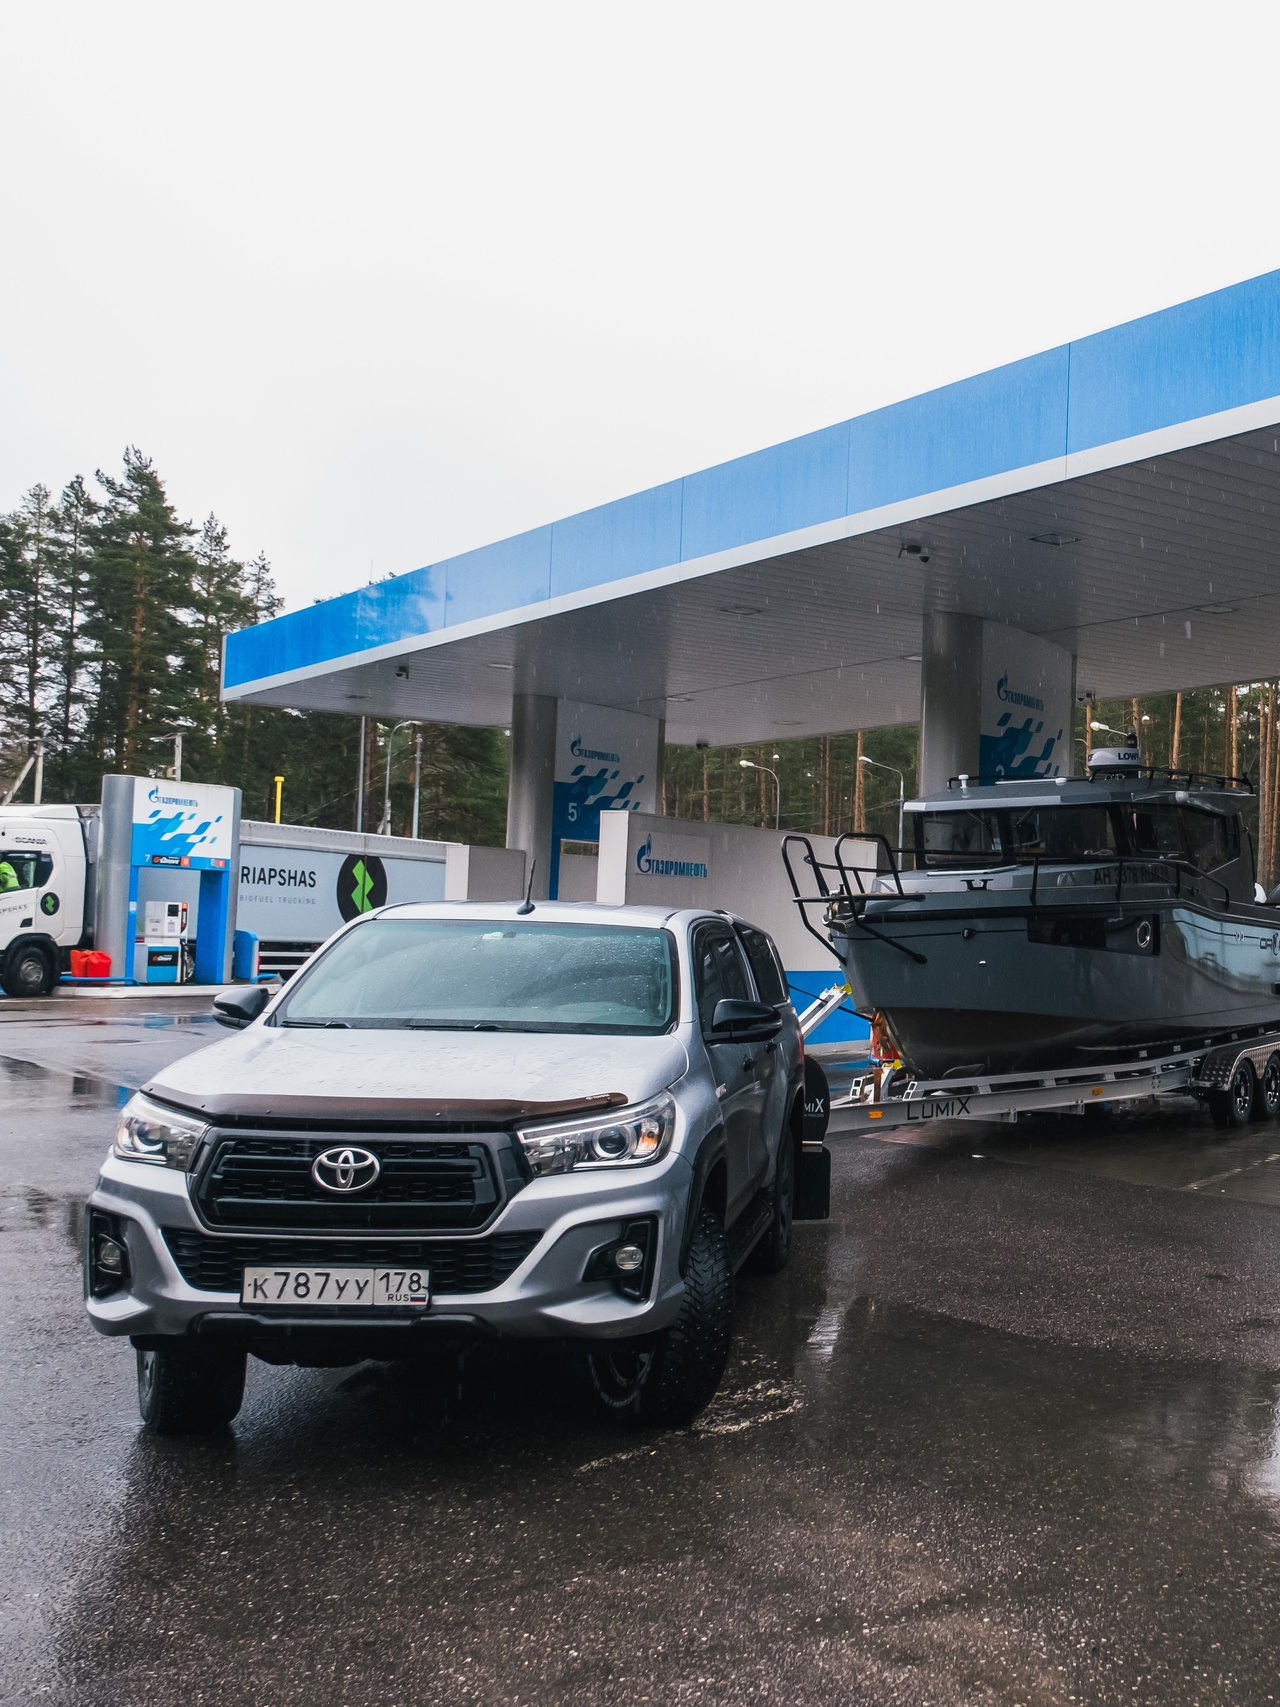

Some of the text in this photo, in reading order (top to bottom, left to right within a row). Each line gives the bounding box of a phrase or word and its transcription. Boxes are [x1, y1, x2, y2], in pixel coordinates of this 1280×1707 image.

[568, 802, 578, 822] 5
[240, 865, 317, 889] RIAPSHAS
[651, 859, 708, 878] ГАЗПРОМНЕФТЬ
[240, 894, 316, 905] BIOFUEL TRUCKING
[804, 1098, 824, 1113] MIX
[907, 1096, 971, 1121] LUMIX
[378, 1271, 422, 1293] 178
[387, 1293, 410, 1302] RUS
